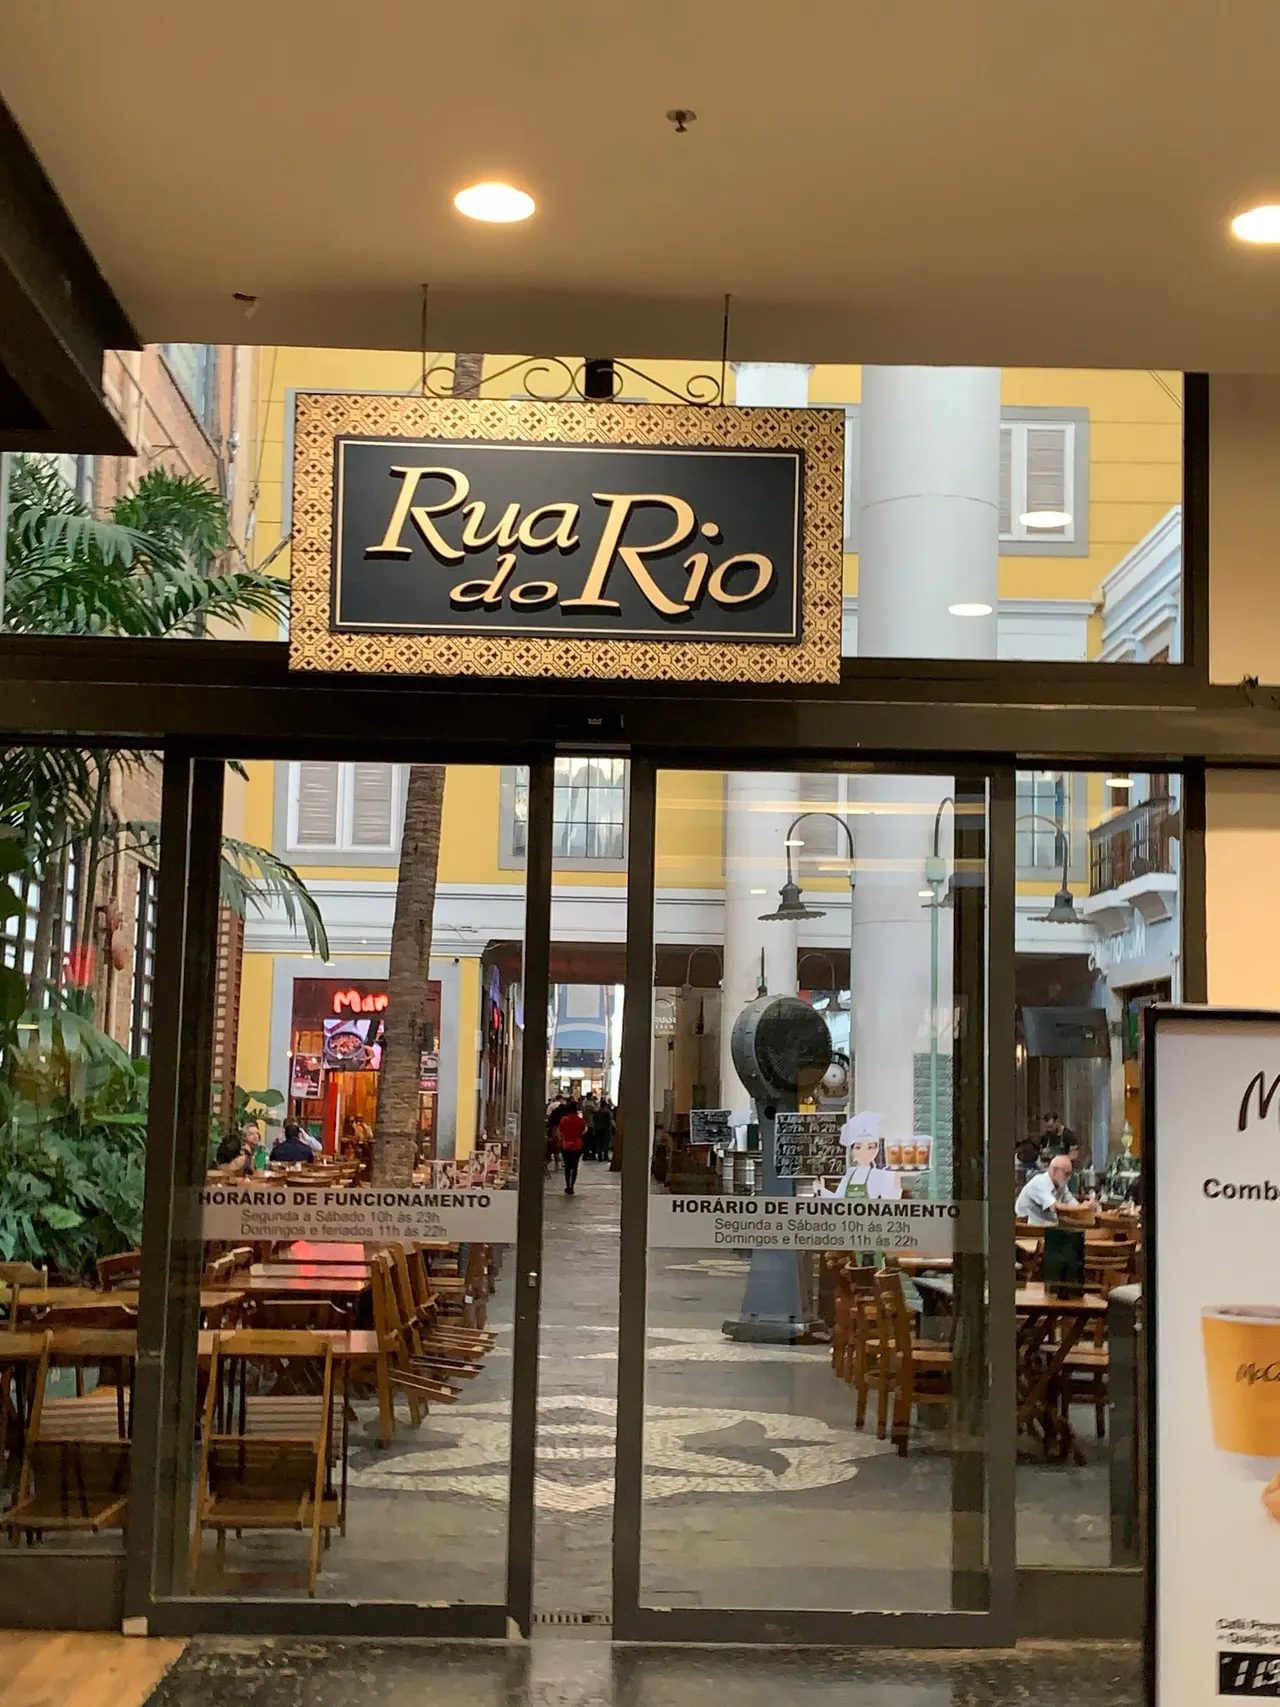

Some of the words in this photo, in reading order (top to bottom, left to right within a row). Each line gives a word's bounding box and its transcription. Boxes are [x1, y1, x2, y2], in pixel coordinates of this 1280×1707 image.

[365, 464, 580, 560] Rua
[448, 552, 559, 606] do
[559, 491, 776, 616] Rio
[1203, 1178, 1280, 1201] Comb
[293, 1192, 318, 1206] DE
[324, 1192, 491, 1209] FUNCIONAMENTO
[672, 1198, 758, 1215] HORÁRIO
[765, 1201, 789, 1216] DE
[795, 1202, 961, 1219] FUNCIONAMENTO
[242, 1209, 300, 1225] Segunda
[304, 1212, 312, 1222] a
[315, 1210, 365, 1223] Sábado
[371, 1211, 393, 1224] 10h
[416, 1211, 441, 1224] 23h
[714, 1217, 772, 1233] Segunda
[775, 1221, 783, 1231] a
[787, 1219, 837, 1233] Sábado
[841, 1220, 864, 1233] 10h
[886, 1221, 911, 1234] 23h
[241, 1223, 306, 1238] Domingos
[309, 1226, 318, 1236] e
[379, 1225, 401, 1237] 11h
[423, 1225, 448, 1238] 22h
[714, 1231, 779, 1247] Domingos
[782, 1234, 790, 1244] e
[794, 1233, 846, 1246] feriados
[849, 1234, 872, 1246] 11h
[894, 1235, 919, 1248] 22h
